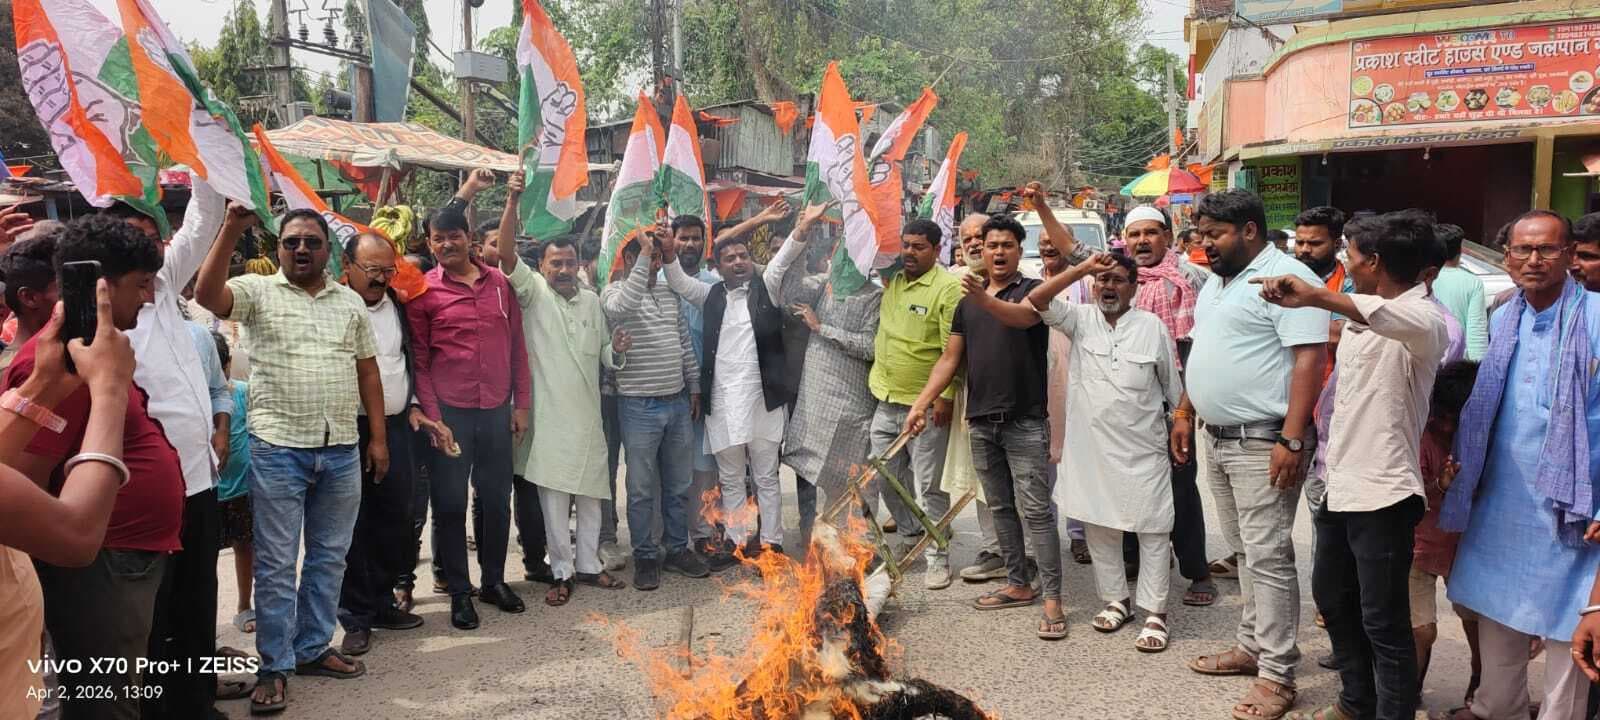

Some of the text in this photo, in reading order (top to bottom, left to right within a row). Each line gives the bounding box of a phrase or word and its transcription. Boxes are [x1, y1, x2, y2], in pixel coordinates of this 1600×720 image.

[1355, 53, 1400, 71] प्रकाश
[1404, 43, 1441, 66] स्वीट
[1444, 46, 1487, 66] हाउस
[1491, 43, 1526, 64] एण्ड
[1527, 38, 1592, 58] जलपान
